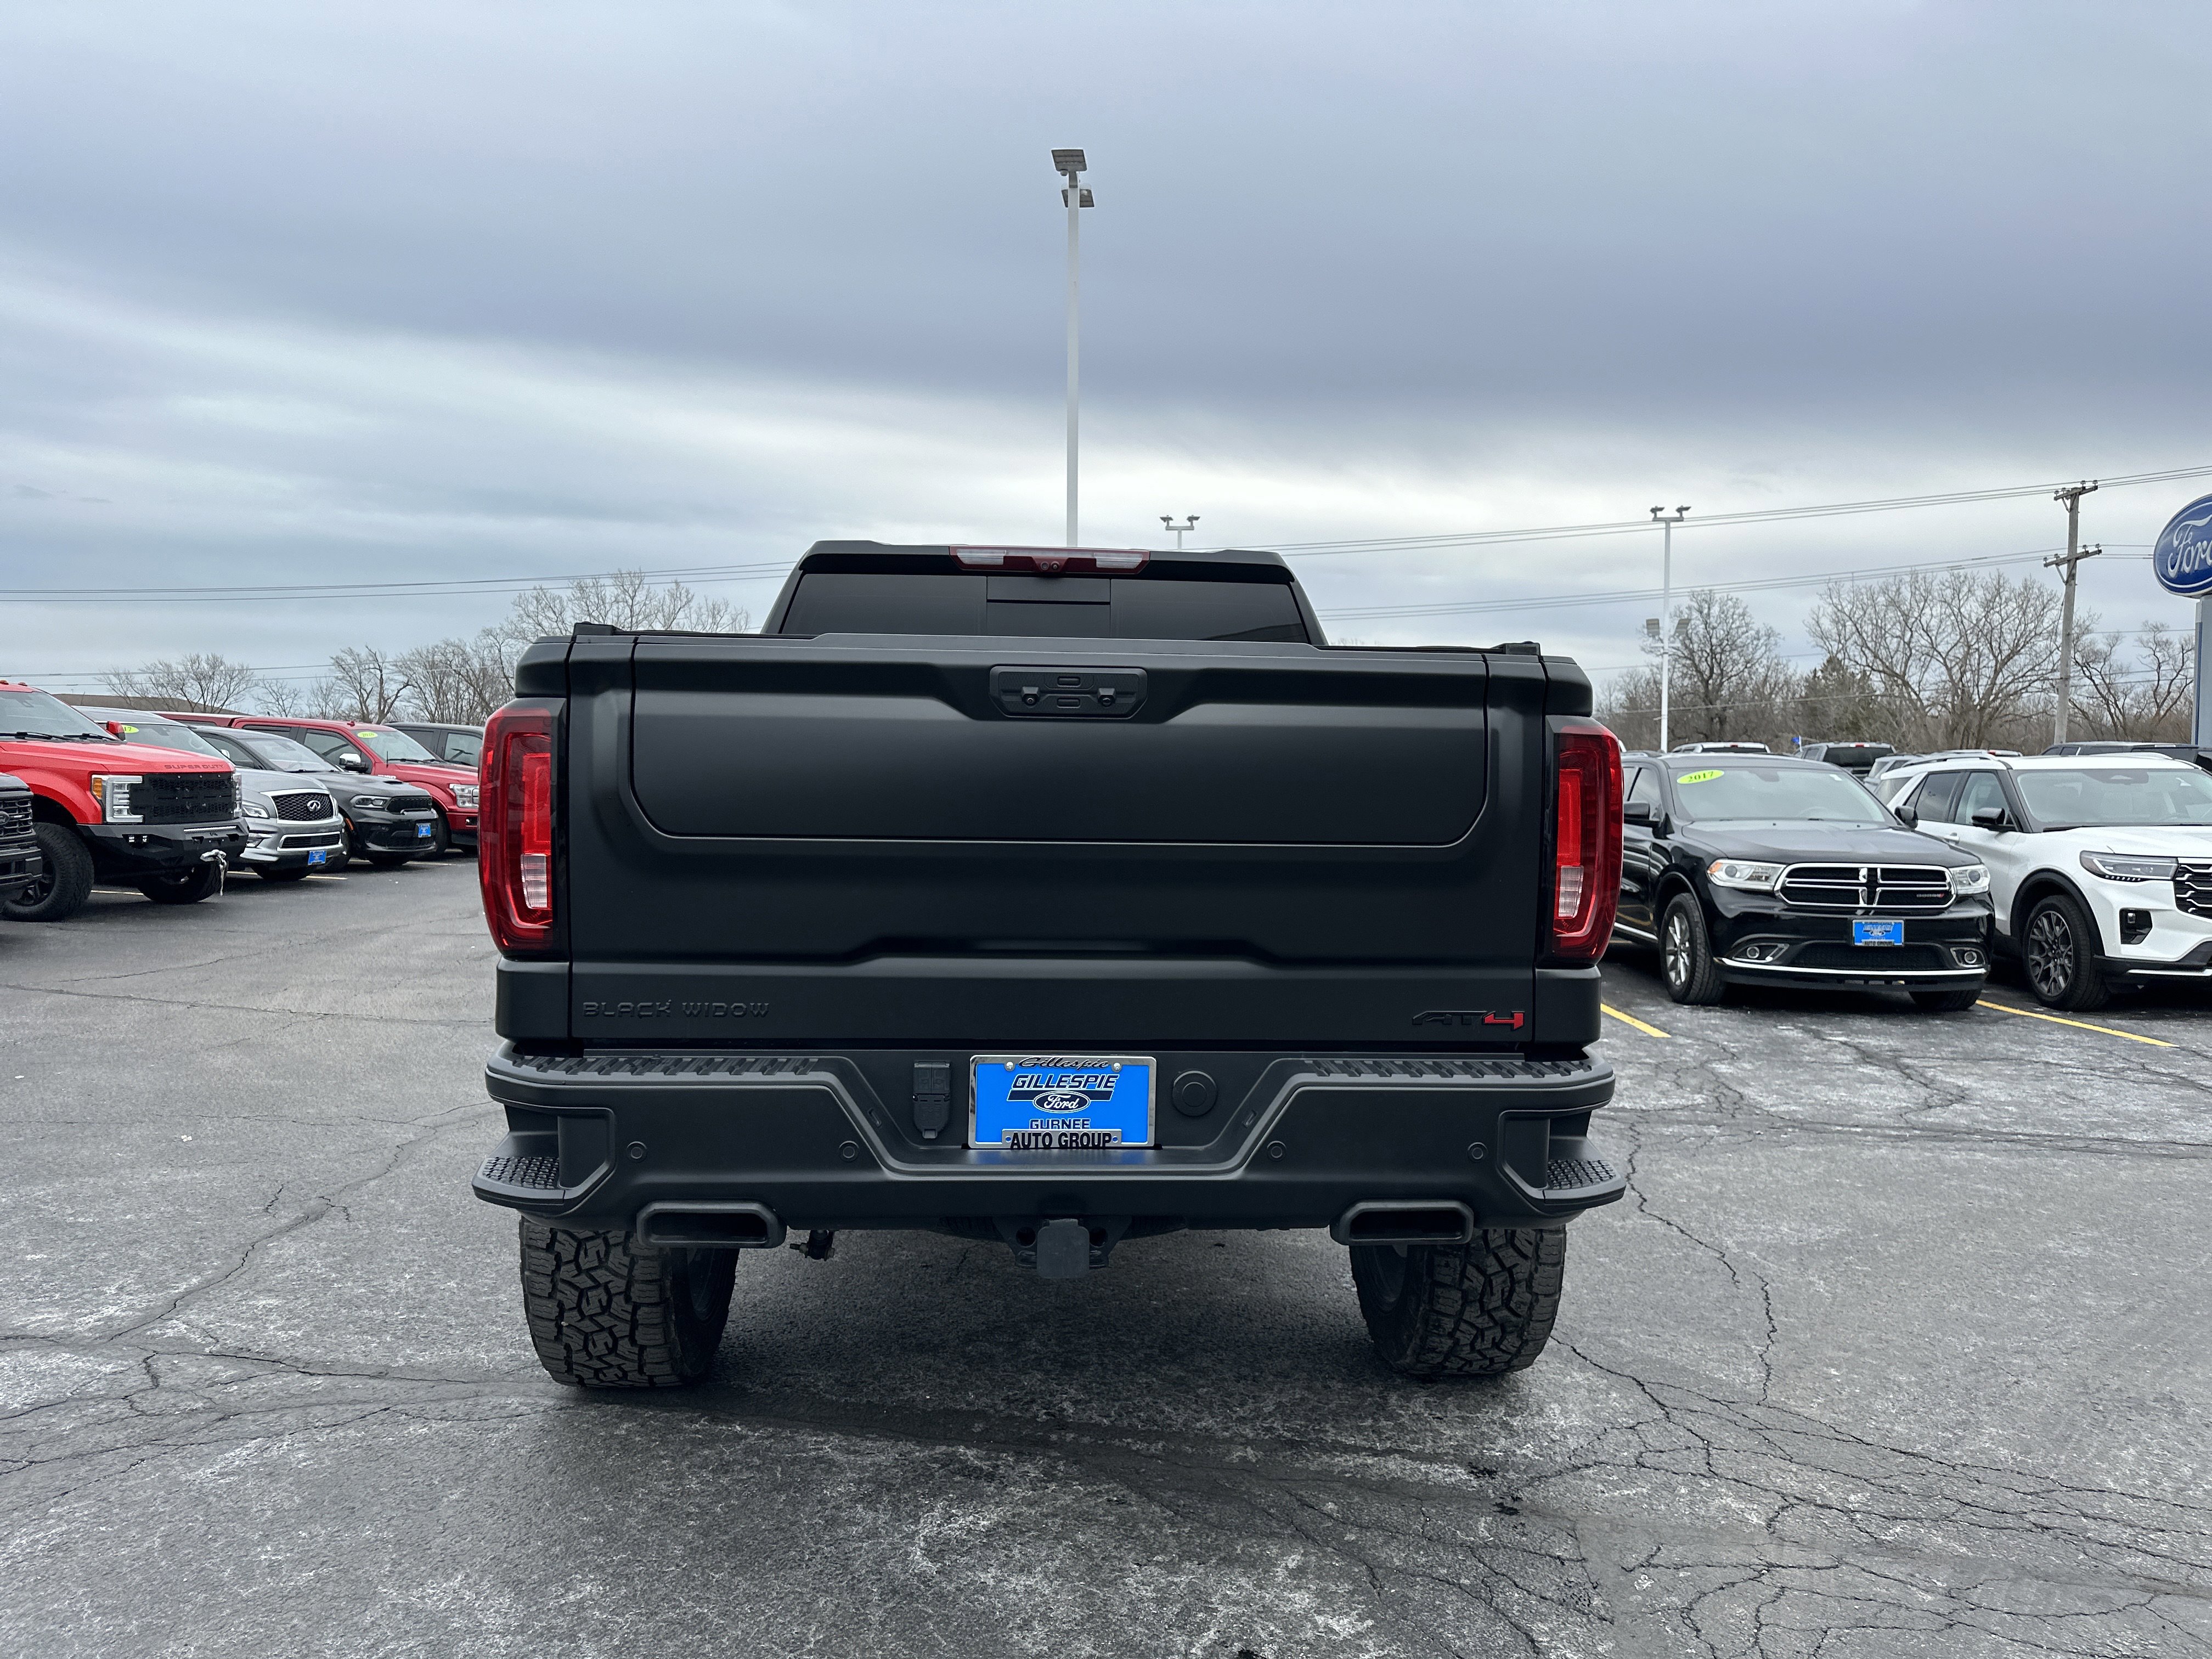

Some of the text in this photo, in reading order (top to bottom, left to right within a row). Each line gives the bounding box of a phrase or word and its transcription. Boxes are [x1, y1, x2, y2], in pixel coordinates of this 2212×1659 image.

[1688, 771, 1713, 782] 2017
[583, 1000, 770, 1019] BLACK WIDOW
[1412, 1010, 1526, 1032] AT4
[1018, 1056, 1110, 1071] Gillespie
[1011, 1074, 1120, 1090] GILLESPIE
[1043, 1093, 1079, 1110] Ford
[1029, 1118, 1091, 1130] GURNEE
[1009, 1131, 1113, 1149] AUTO GROUP
